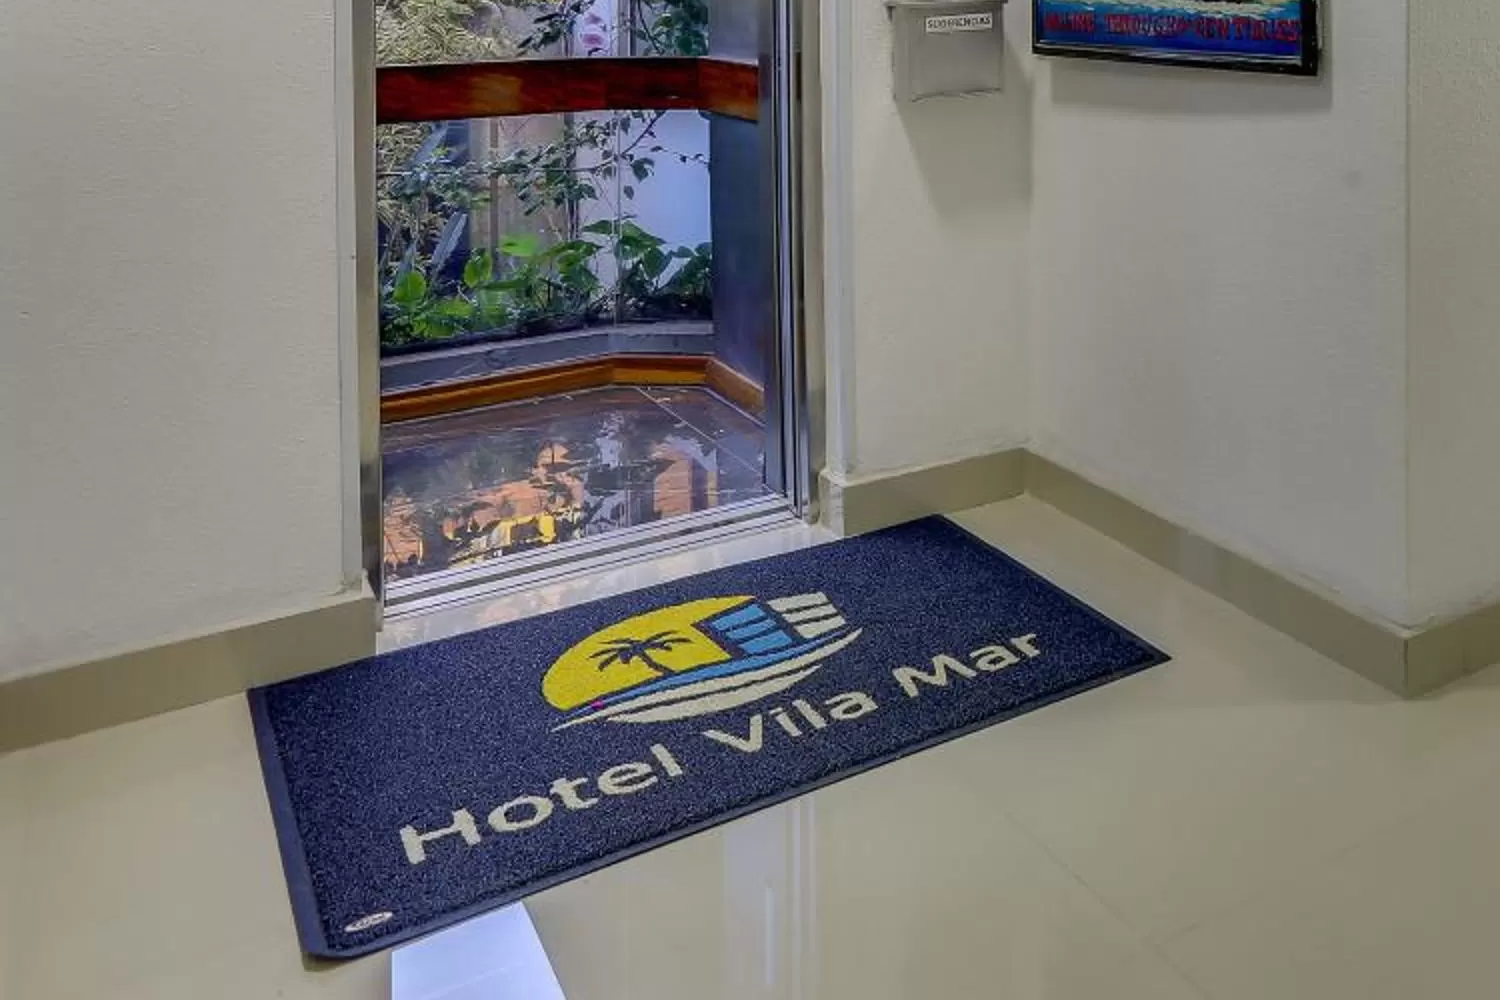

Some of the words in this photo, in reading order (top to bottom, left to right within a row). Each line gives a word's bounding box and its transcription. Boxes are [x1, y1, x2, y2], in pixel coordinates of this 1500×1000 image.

[400, 743, 682, 864] Hotel
[703, 690, 876, 753] Vila
[893, 629, 1042, 699] Mar
